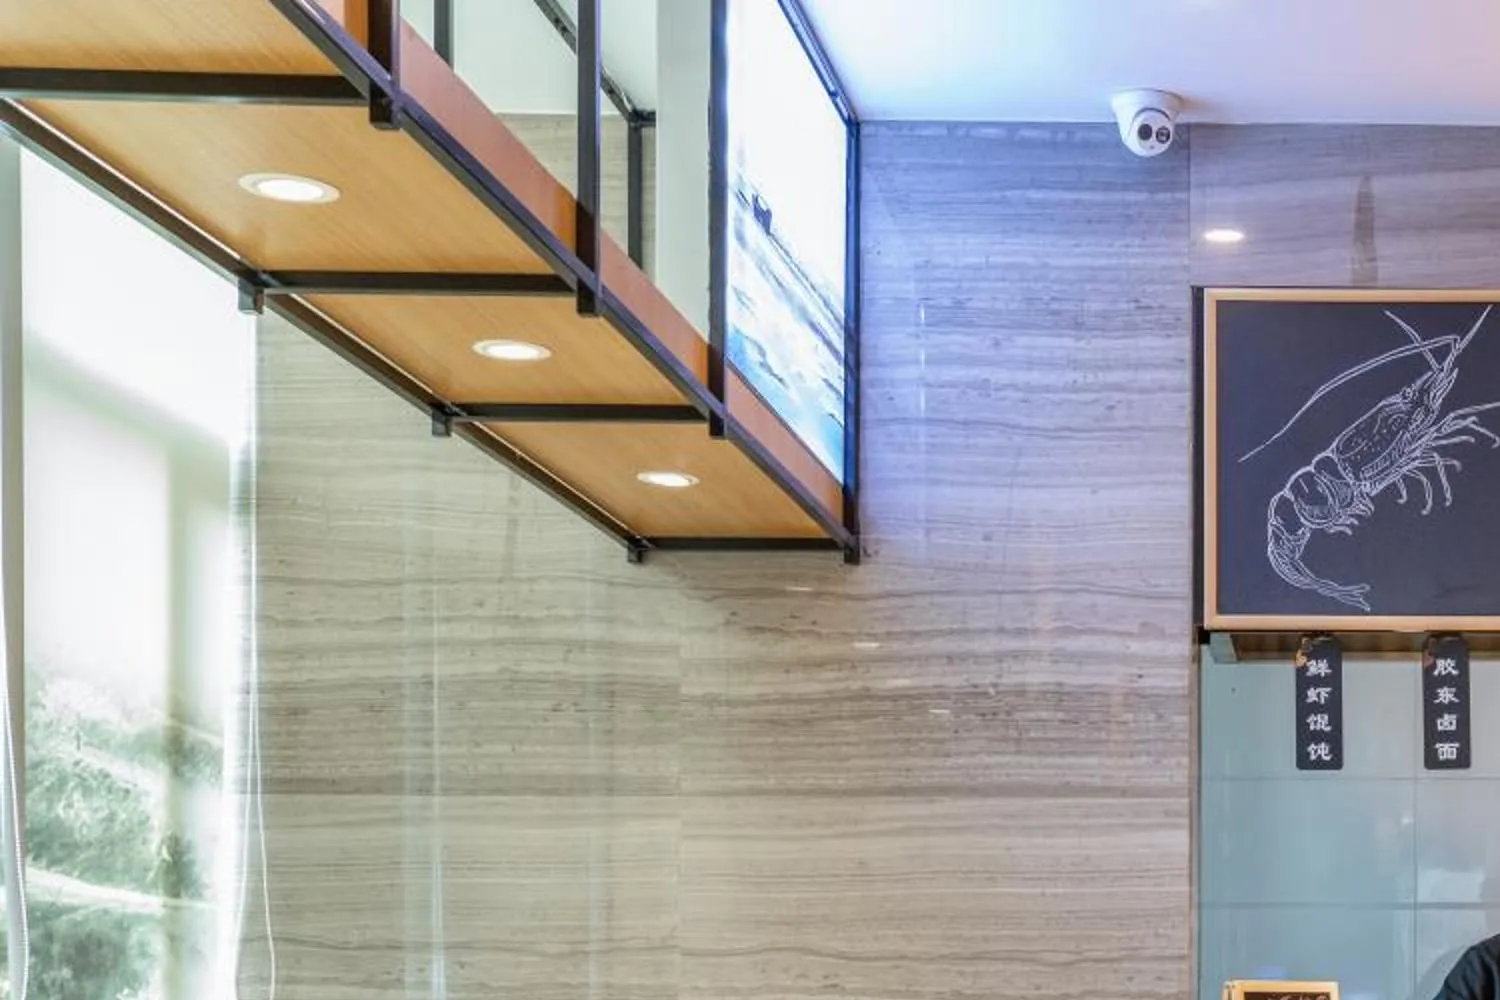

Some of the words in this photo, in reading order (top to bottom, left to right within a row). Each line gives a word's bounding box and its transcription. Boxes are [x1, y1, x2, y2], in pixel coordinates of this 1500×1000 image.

[1306, 658, 1333, 761] 鲜虾馄饨
[1433, 658, 1460, 761] 胶东卤面
